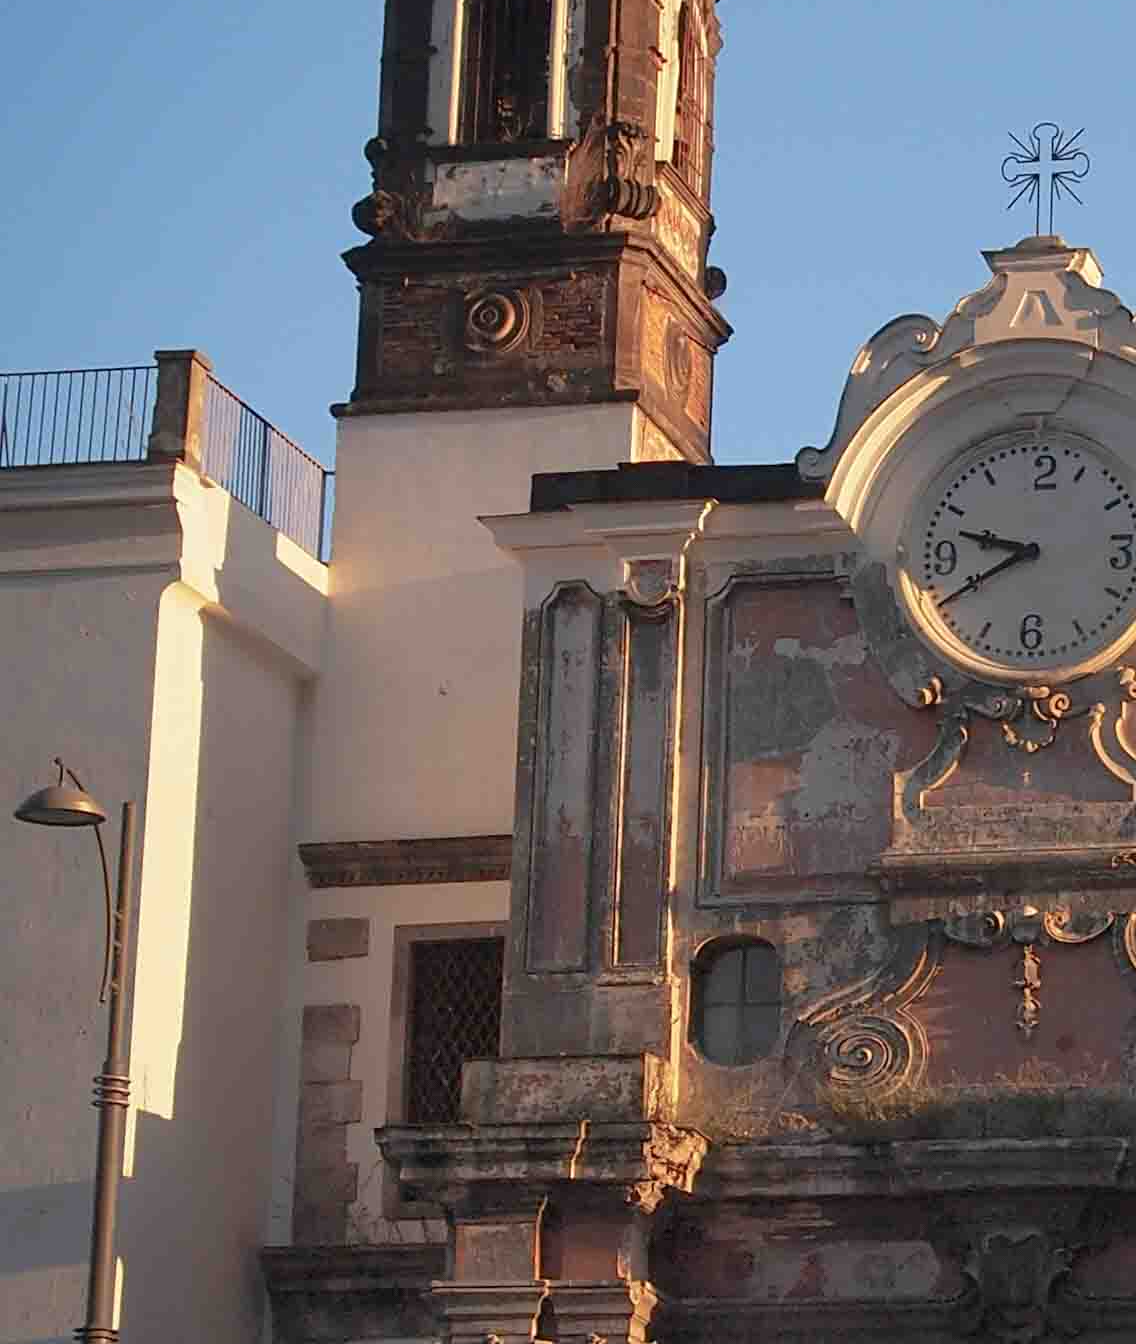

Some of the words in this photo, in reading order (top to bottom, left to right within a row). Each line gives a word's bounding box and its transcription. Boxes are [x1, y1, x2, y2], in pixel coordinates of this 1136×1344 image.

[933, 539, 957, 576] 9
[1109, 533, 1134, 571] 3
[1019, 614, 1043, 651] 6
